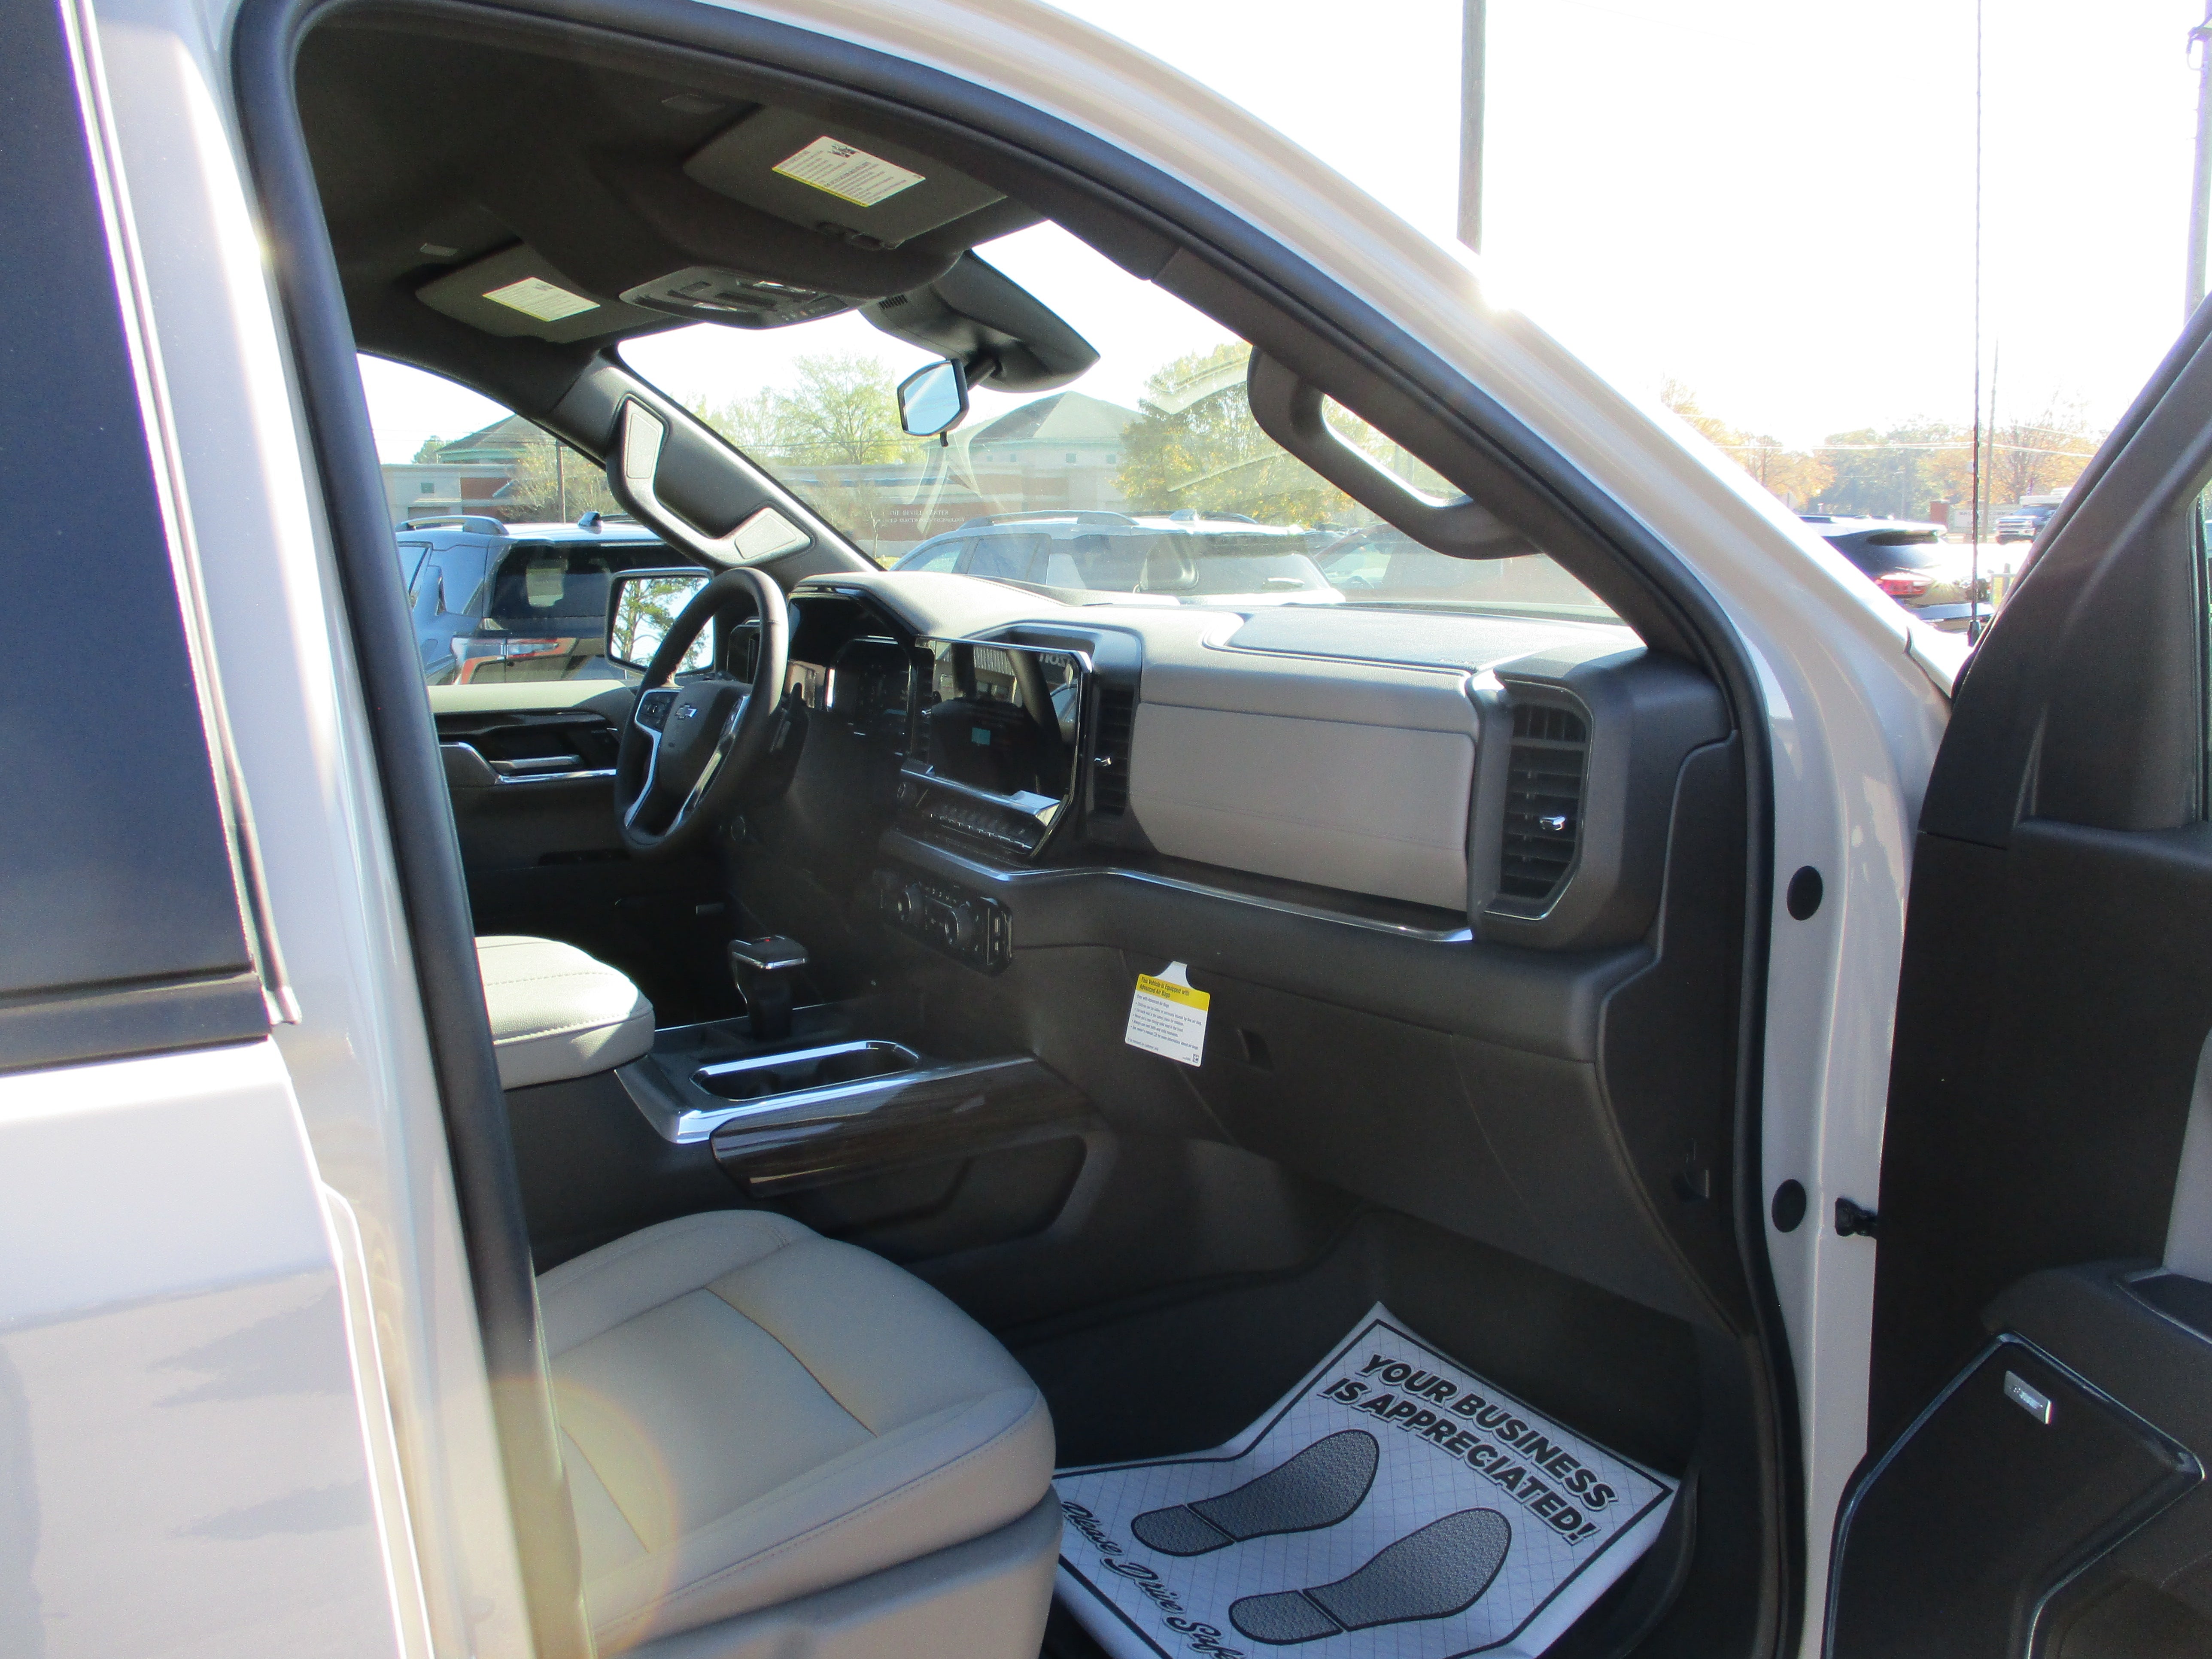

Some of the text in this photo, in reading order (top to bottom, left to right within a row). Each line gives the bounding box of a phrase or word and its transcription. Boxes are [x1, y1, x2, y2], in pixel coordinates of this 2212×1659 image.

[1140, 984, 1155, 992] Advanced
[1164, 984, 1181, 994] Equipped
[1319, 1377, 1599, 1544] IS APPRECIATED!
[1357, 1354, 1618, 1510] YOUR BUSINESS
[1100, 1555, 1185, 1613] Drive
